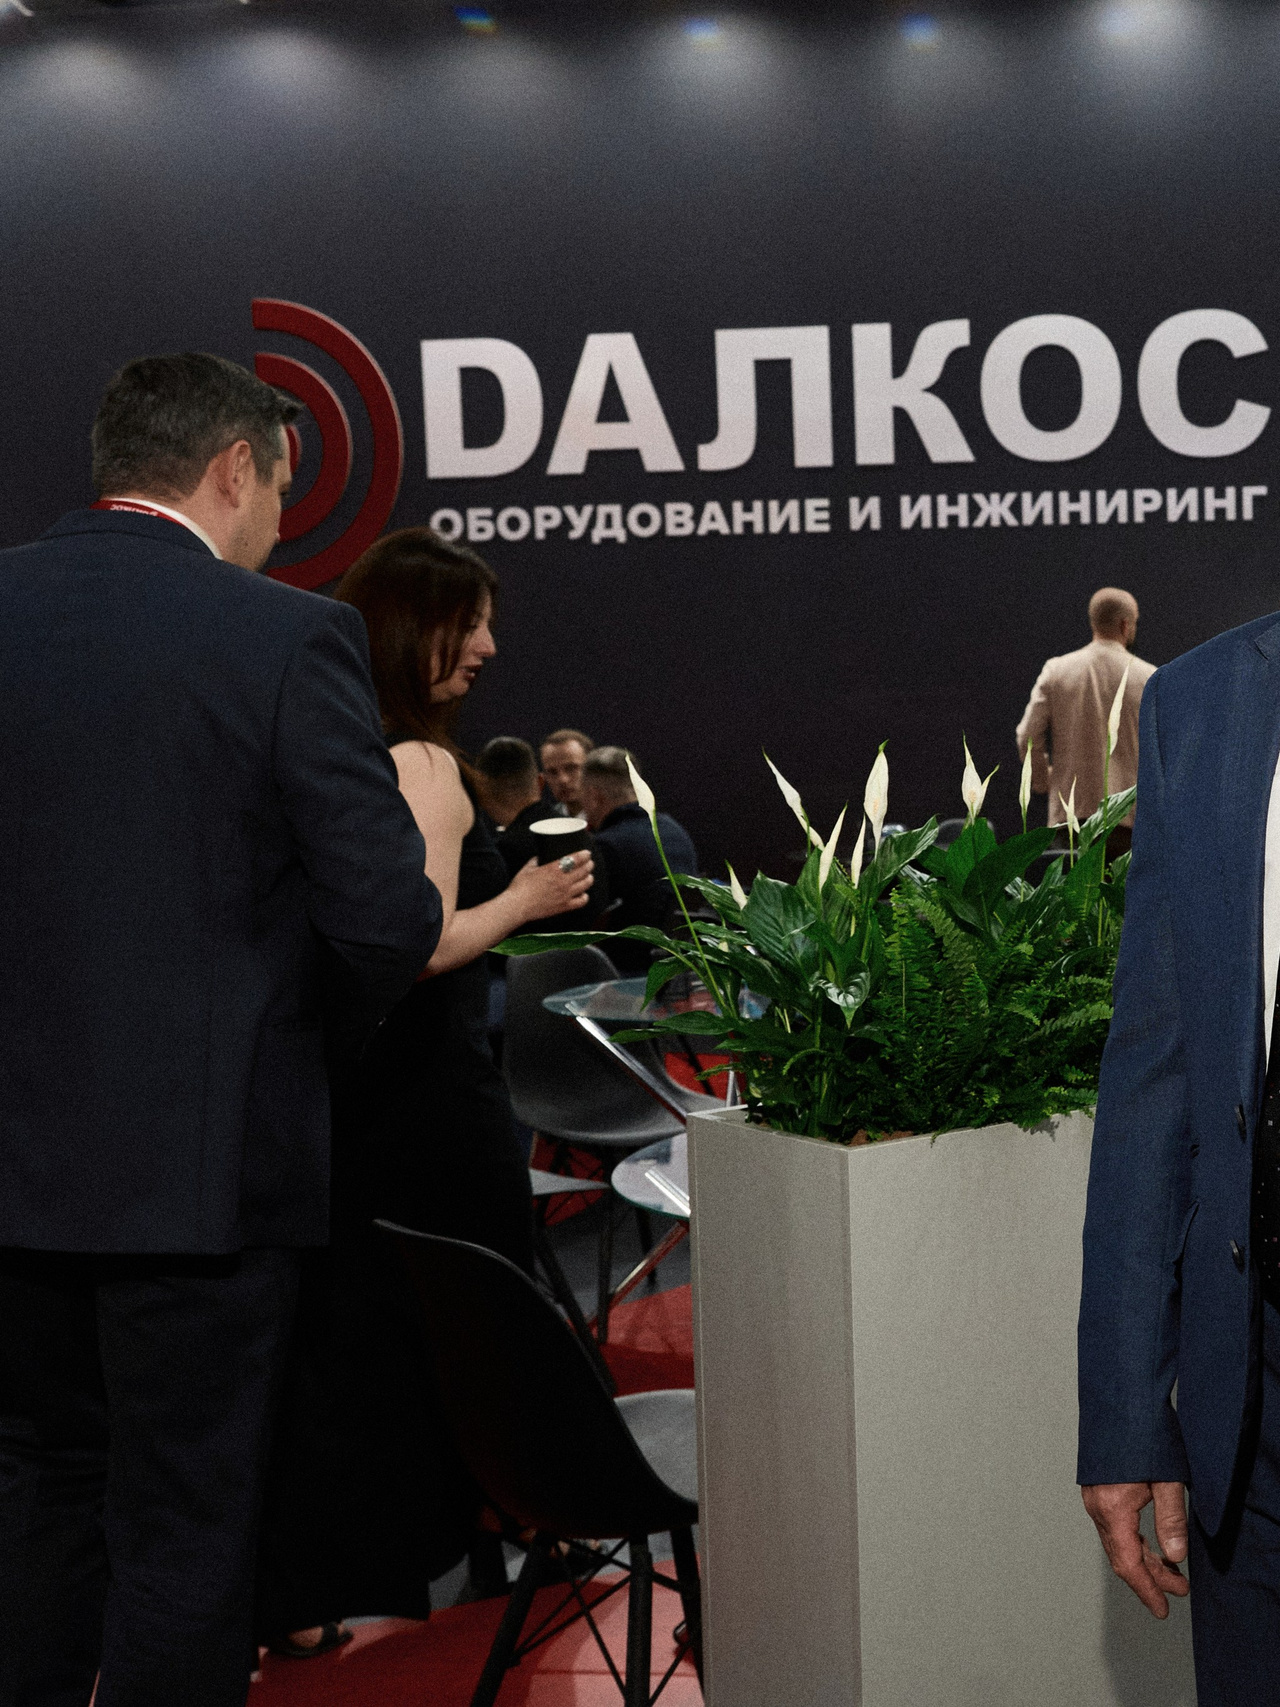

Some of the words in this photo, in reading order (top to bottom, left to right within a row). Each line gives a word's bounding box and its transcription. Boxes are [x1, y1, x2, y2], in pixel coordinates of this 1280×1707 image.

[431, 499, 830, 544] ОБОРУДОВАНИЕ
[850, 497, 880, 531] И
[901, 486, 1267, 529] ИНЖИНИРИНГ
